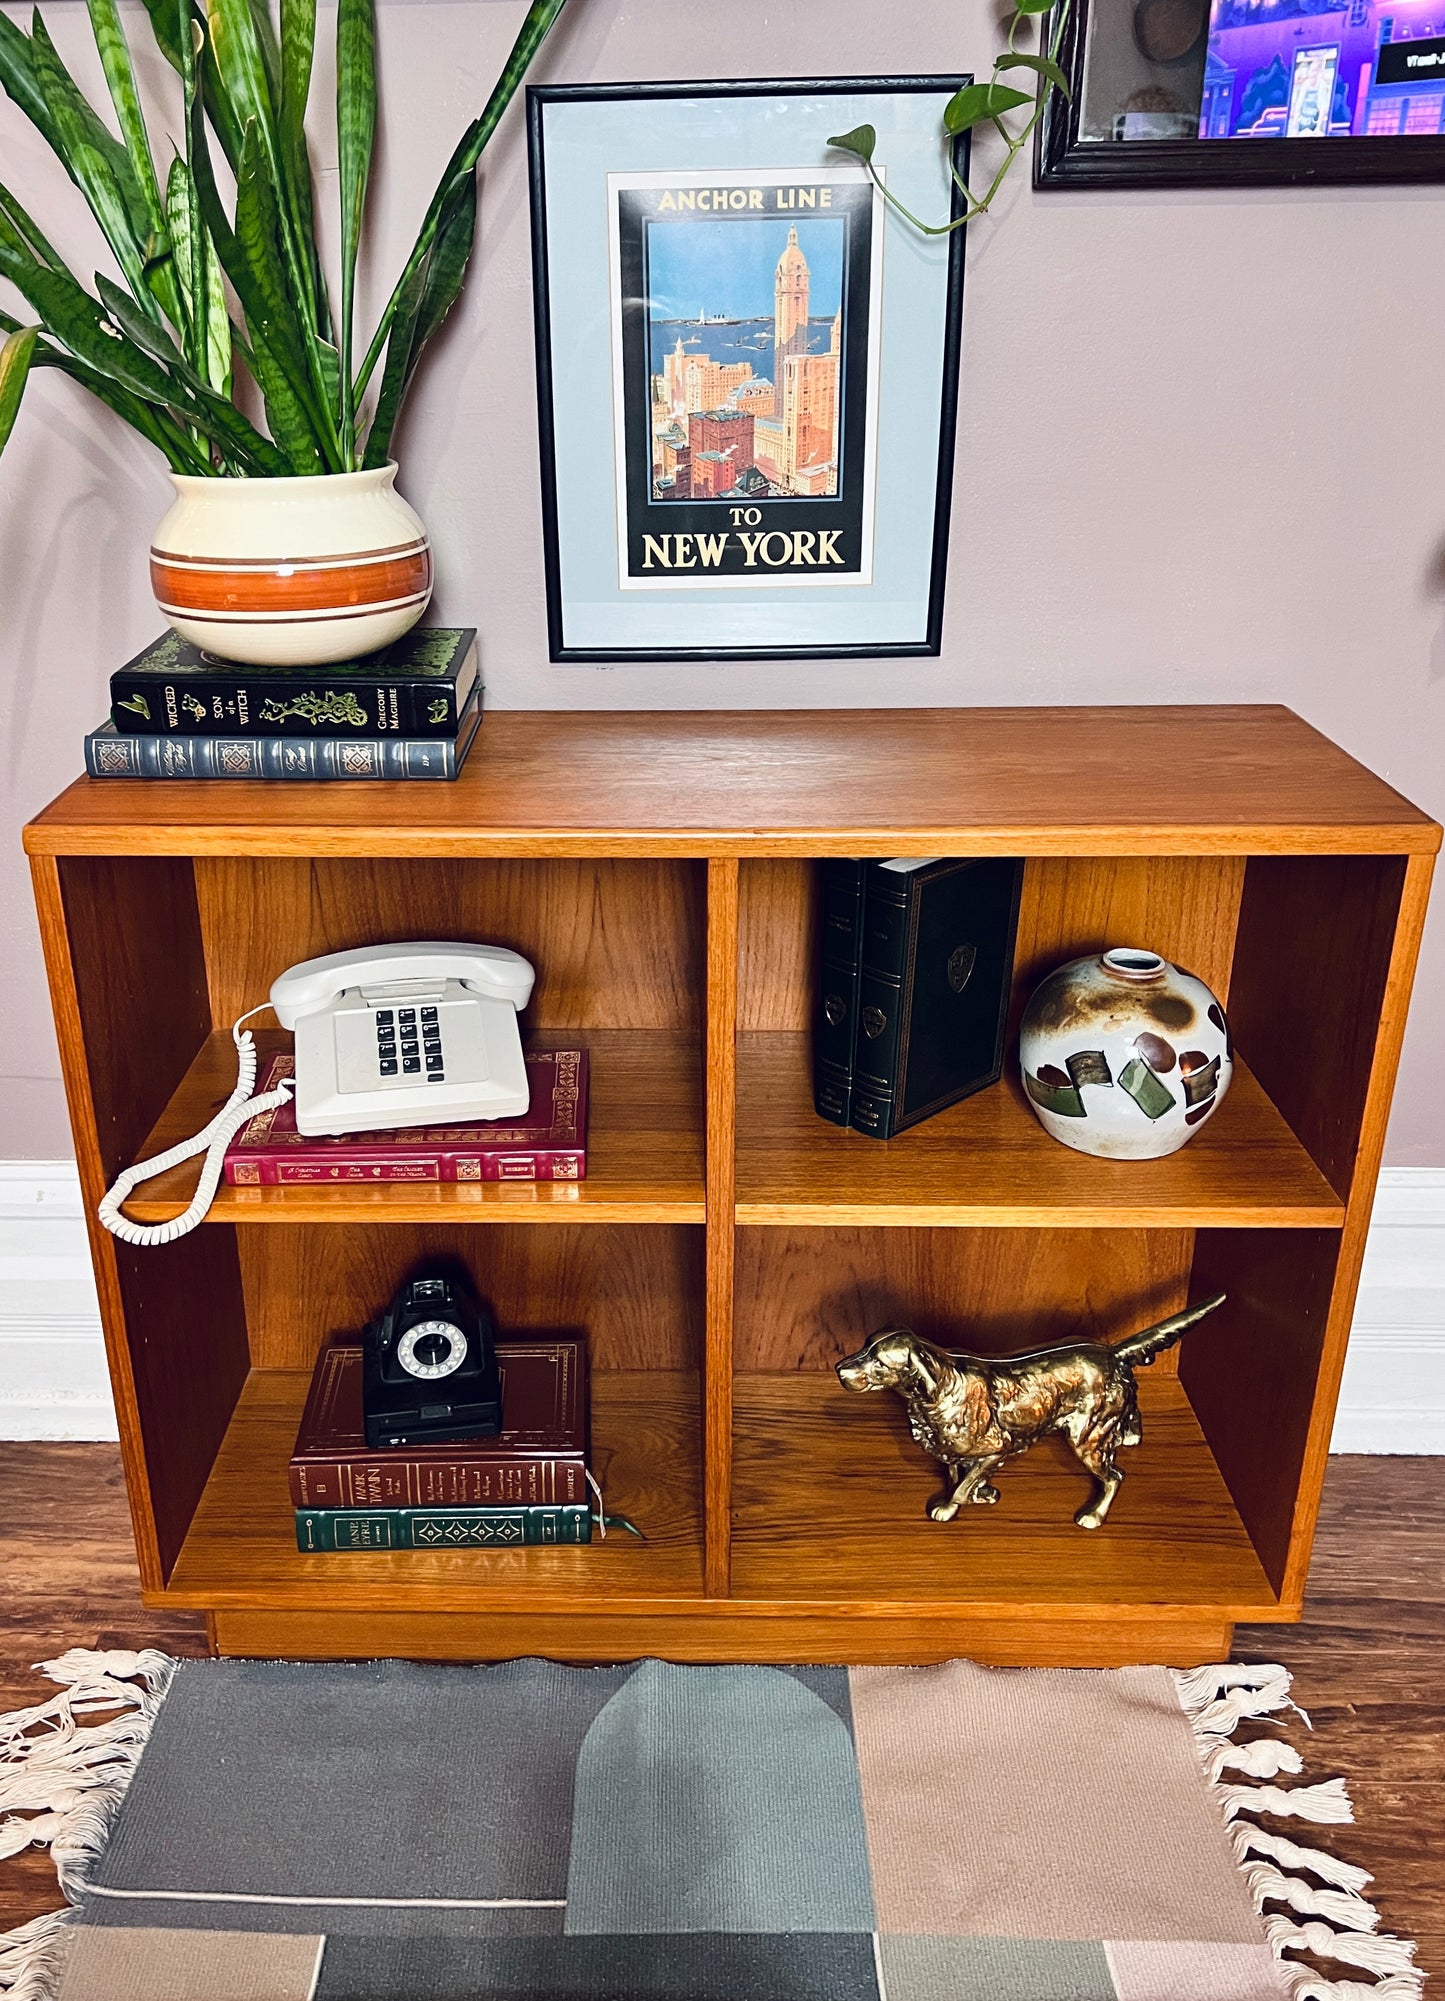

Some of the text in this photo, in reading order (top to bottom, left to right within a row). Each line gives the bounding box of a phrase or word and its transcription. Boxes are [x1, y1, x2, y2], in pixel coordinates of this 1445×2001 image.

[658, 187, 833, 211] ANCHOR LINE
[728, 507, 762, 526] TO
[641, 530, 845, 568] NEW YORK
[165, 686, 179, 728] WICKED
[212, 696, 224, 719] SON
[225, 706, 236, 715] of
[237, 689, 250, 725] WITCH
[377, 688, 387, 729] GREGORY
[389, 688, 399, 729] MAGUIRE
[355, 1473, 367, 1500] MARK
[367, 1469, 382, 1503] TWAIN
[349, 1521, 361, 1545] JANE
[361, 1521, 371, 1545] EYRE
